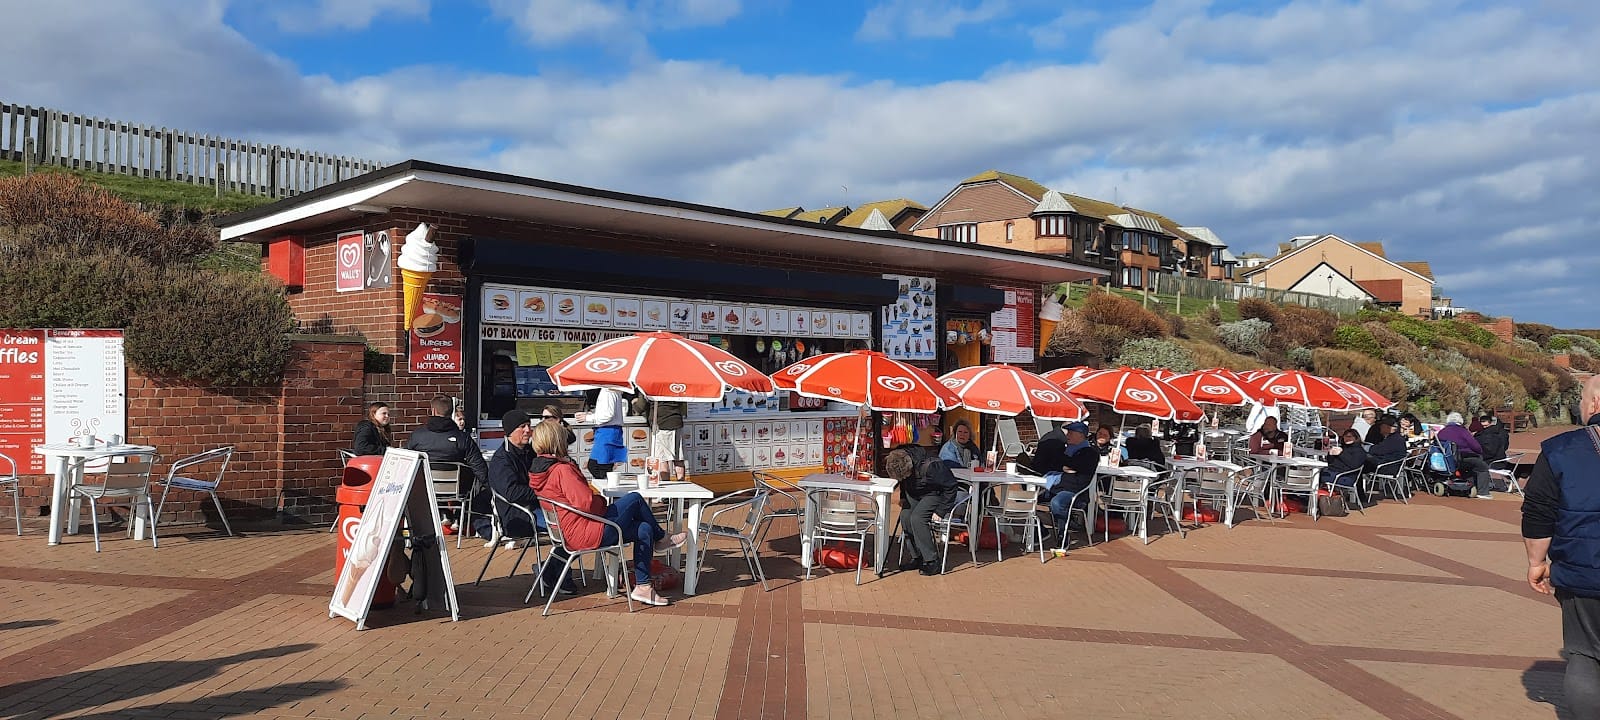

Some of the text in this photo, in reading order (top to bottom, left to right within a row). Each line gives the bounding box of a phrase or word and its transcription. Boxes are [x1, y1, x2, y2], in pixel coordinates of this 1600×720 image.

[501, 328, 529, 340] BACON
[538, 330, 555, 341] EGG
[563, 331, 597, 342] TOMATO
[4, 335, 38, 344] Cream
[423, 353, 449, 361] JUMBO
[417, 362, 455, 370] HOT DOGS
